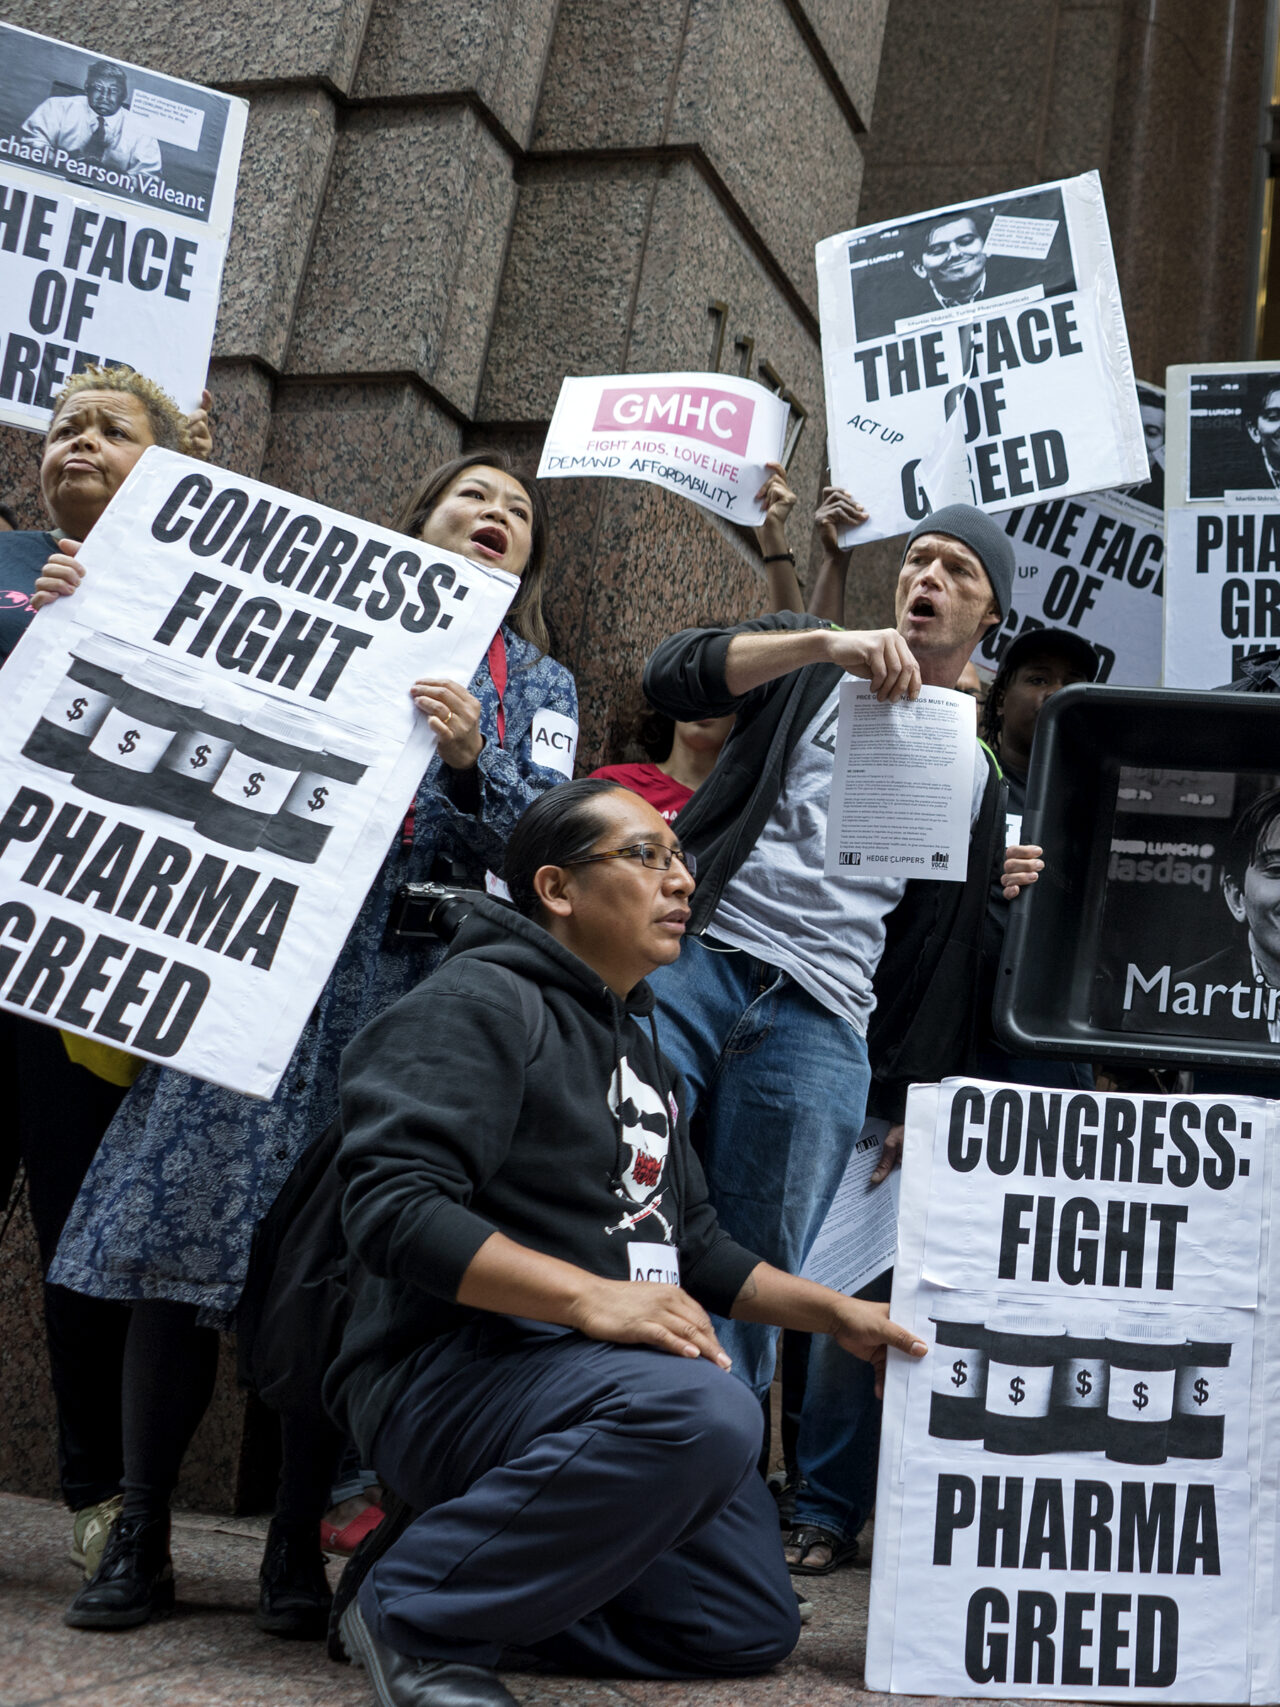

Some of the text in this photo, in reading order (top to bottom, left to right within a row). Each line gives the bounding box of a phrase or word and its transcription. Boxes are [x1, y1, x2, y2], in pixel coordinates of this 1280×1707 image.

[0, 136, 206, 211] chael Pearson, Valeant
[0, 185, 199, 303] HE FACE
[29, 269, 100, 342] OF
[854, 300, 1084, 402] THE FACE
[612, 393, 737, 439] GMHC
[847, 413, 905, 445] ACT UP
[944, 378, 1007, 444] OF
[548, 456, 737, 510] DEMAND AFFORDABILITY.
[587, 440, 740, 484] FIGHT AIDS. LOVE LIFE.
[901, 429, 1070, 521] GEED
[150, 473, 469, 635] CONGRESS:
[1018, 566, 1039, 578] UP
[1080, 514, 1164, 597] FAC
[153, 571, 374, 703] FIGHT
[1042, 565, 1104, 628] OF
[535, 727, 573, 753] ACT
[0, 785, 300, 971] PHARMA
[866, 855, 926, 865] HEDGE CLIPPERS
[0, 901, 211, 1058] GREED
[947, 1086, 1253, 1191] CONGRESS:
[997, 1193, 1189, 1291] FIGHT
[932, 1473, 1222, 1577] PHARMA
[965, 1586, 1179, 1689] GREED
